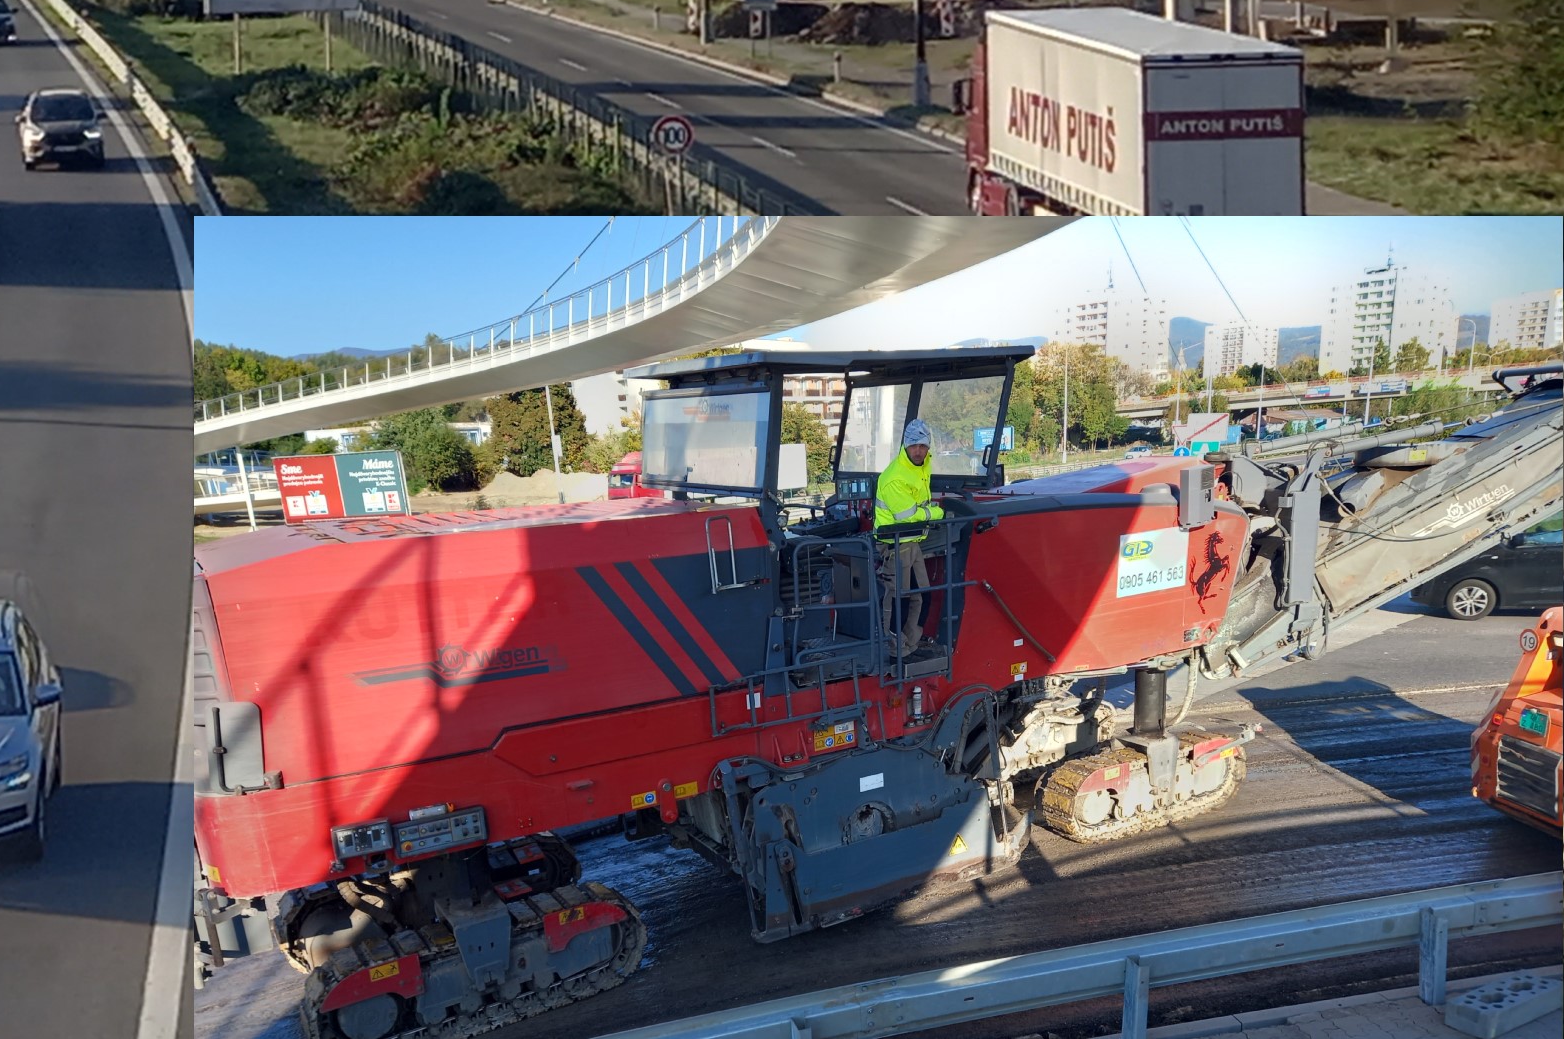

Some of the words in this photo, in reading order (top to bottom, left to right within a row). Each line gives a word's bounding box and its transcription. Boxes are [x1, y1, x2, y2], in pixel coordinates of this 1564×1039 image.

[1007, 86, 1062, 153] ANTON
[1066, 105, 1116, 174] PUTIŠ
[1160, 119, 1224, 135] ANTON
[1229, 114, 1285, 132] PUTIŠ
[280, 463, 303, 474] Sme
[362, 458, 394, 470] Máme
[1119, 572, 1143, 590] 0905
[1146, 570, 1163, 584] 461
[1167, 565, 1184, 581] 563
[1522, 635, 1535, 649] 19
